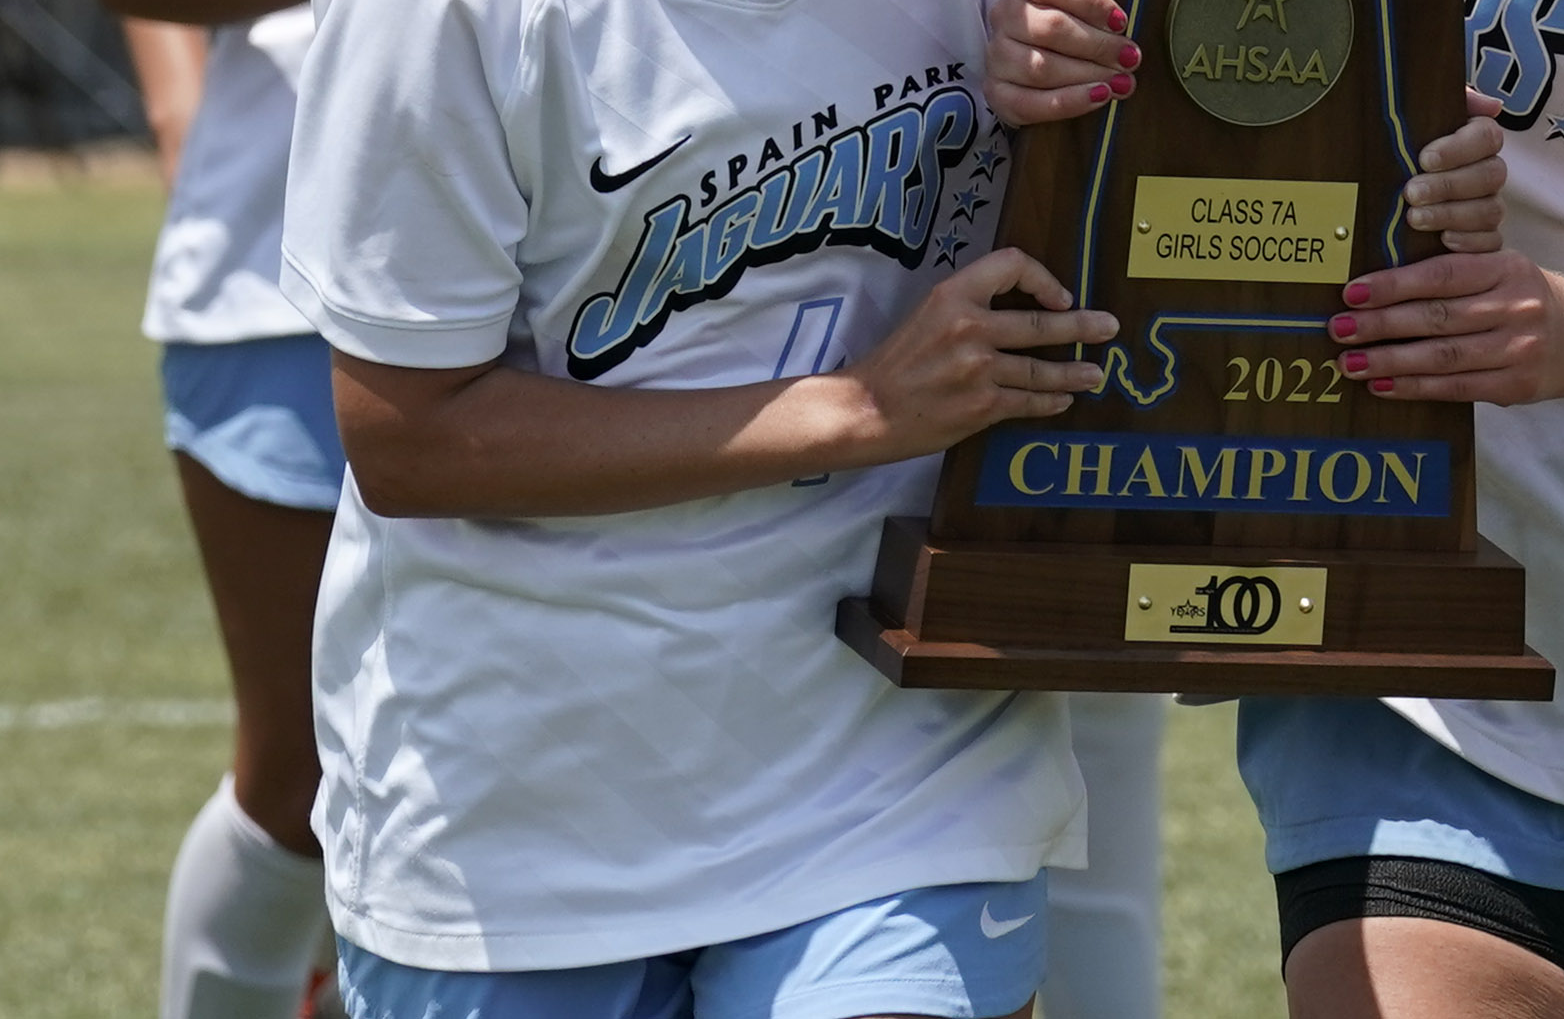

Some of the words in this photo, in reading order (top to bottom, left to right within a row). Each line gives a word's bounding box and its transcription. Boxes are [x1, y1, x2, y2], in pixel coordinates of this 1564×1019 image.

[1182, 43, 1330, 85] AHSAA
[701, 104, 838, 207] SPAIN
[874, 62, 966, 110] PARK
[566, 86, 978, 381] JAGUARS
[1191, 198, 1264, 225] CLASS
[1271, 201, 1297, 226] 7A
[1156, 233, 1222, 260] GIRLS
[1229, 235, 1325, 263] SOCCER
[1223, 356, 1343, 403] 2022
[1008, 441, 1428, 505] CHAMPION
[1195, 575, 1281, 635] 100
